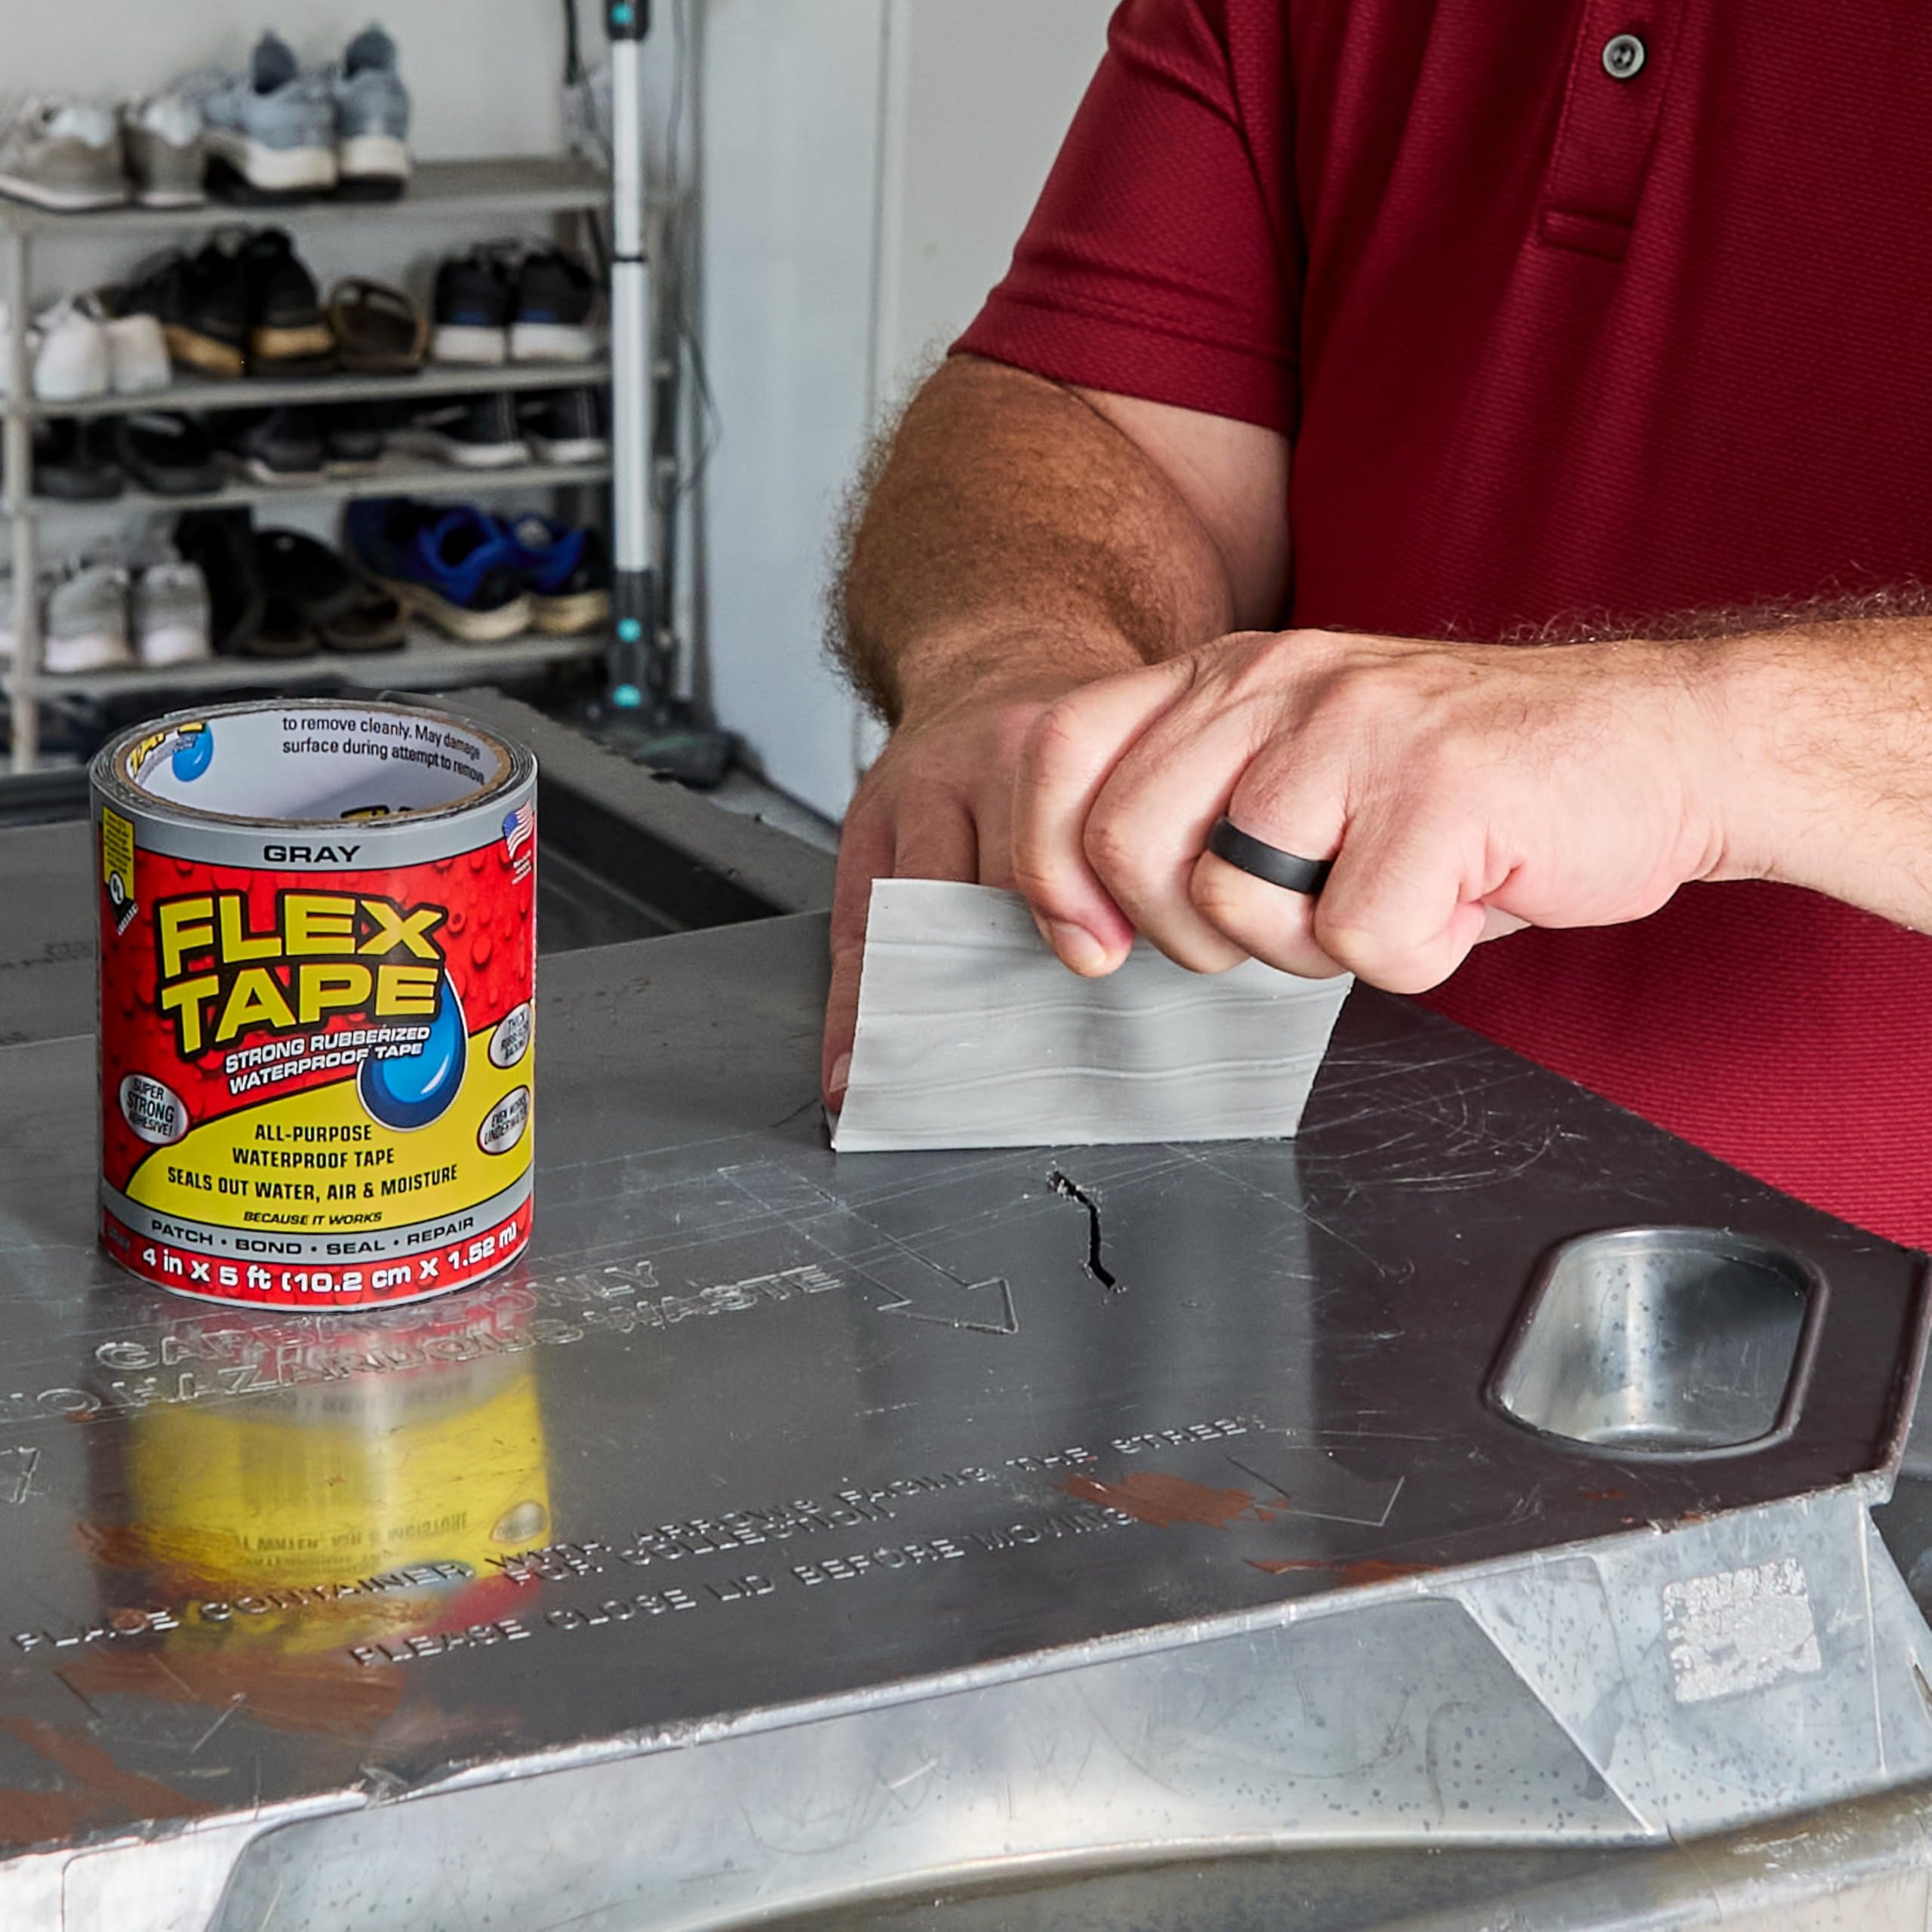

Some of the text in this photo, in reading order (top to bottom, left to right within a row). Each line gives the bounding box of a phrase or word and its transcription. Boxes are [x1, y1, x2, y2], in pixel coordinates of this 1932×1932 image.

[282, 717, 297, 731] to
[301, 718, 356, 731] remove
[360, 718, 412, 740] cleanly.
[415, 724, 442, 746] May
[282, 737, 339, 753] surface
[343, 740, 388, 760] during
[392, 746, 439, 769] attempt
[441, 755, 452, 771] to
[263, 844, 361, 863] GRAY
[158, 893, 444, 980] FLEX
[160, 962, 439, 1055] TAPE
[225, 1026, 430, 1075] STRONG RUBBERIZED
[229, 1042, 423, 1095] WATERPROOF TAPE
[127, 1091, 175, 1123] STRONG
[133, 1077, 164, 1101] SUPER
[255, 1124, 372, 1142] ALL-PURPOSE
[232, 1147, 395, 1169] WATERPROOF TAPE
[168, 1163, 458, 1204] SEALS OUT WATER, AIR & MOISTURE
[152, 1220, 213, 1246] PATCH
[235, 1238, 302, 1254] BOND
[327, 1240, 386, 1255] SEAL
[407, 1216, 474, 1246] REPAIR
[244, 1211, 383, 1226] BECAUSE IT WORKS
[142, 1247, 157, 1267] 4
[163, 1248, 183, 1275] in
[219, 1266, 238, 1287] 5
[246, 1264, 272, 1291] ft
[281, 1272, 363, 1293] (10.2
[371, 1265, 411, 1289] cm
[448, 1236, 495, 1270] 1.52
[499, 1221, 517, 1250] m)
[349, 1507, 1132, 1666] PLEASE CLOSE LID BEFORE MOVING
[11, 1610, 180, 1653] PLACE
[198, 1561, 473, 1621] CONTAINER
